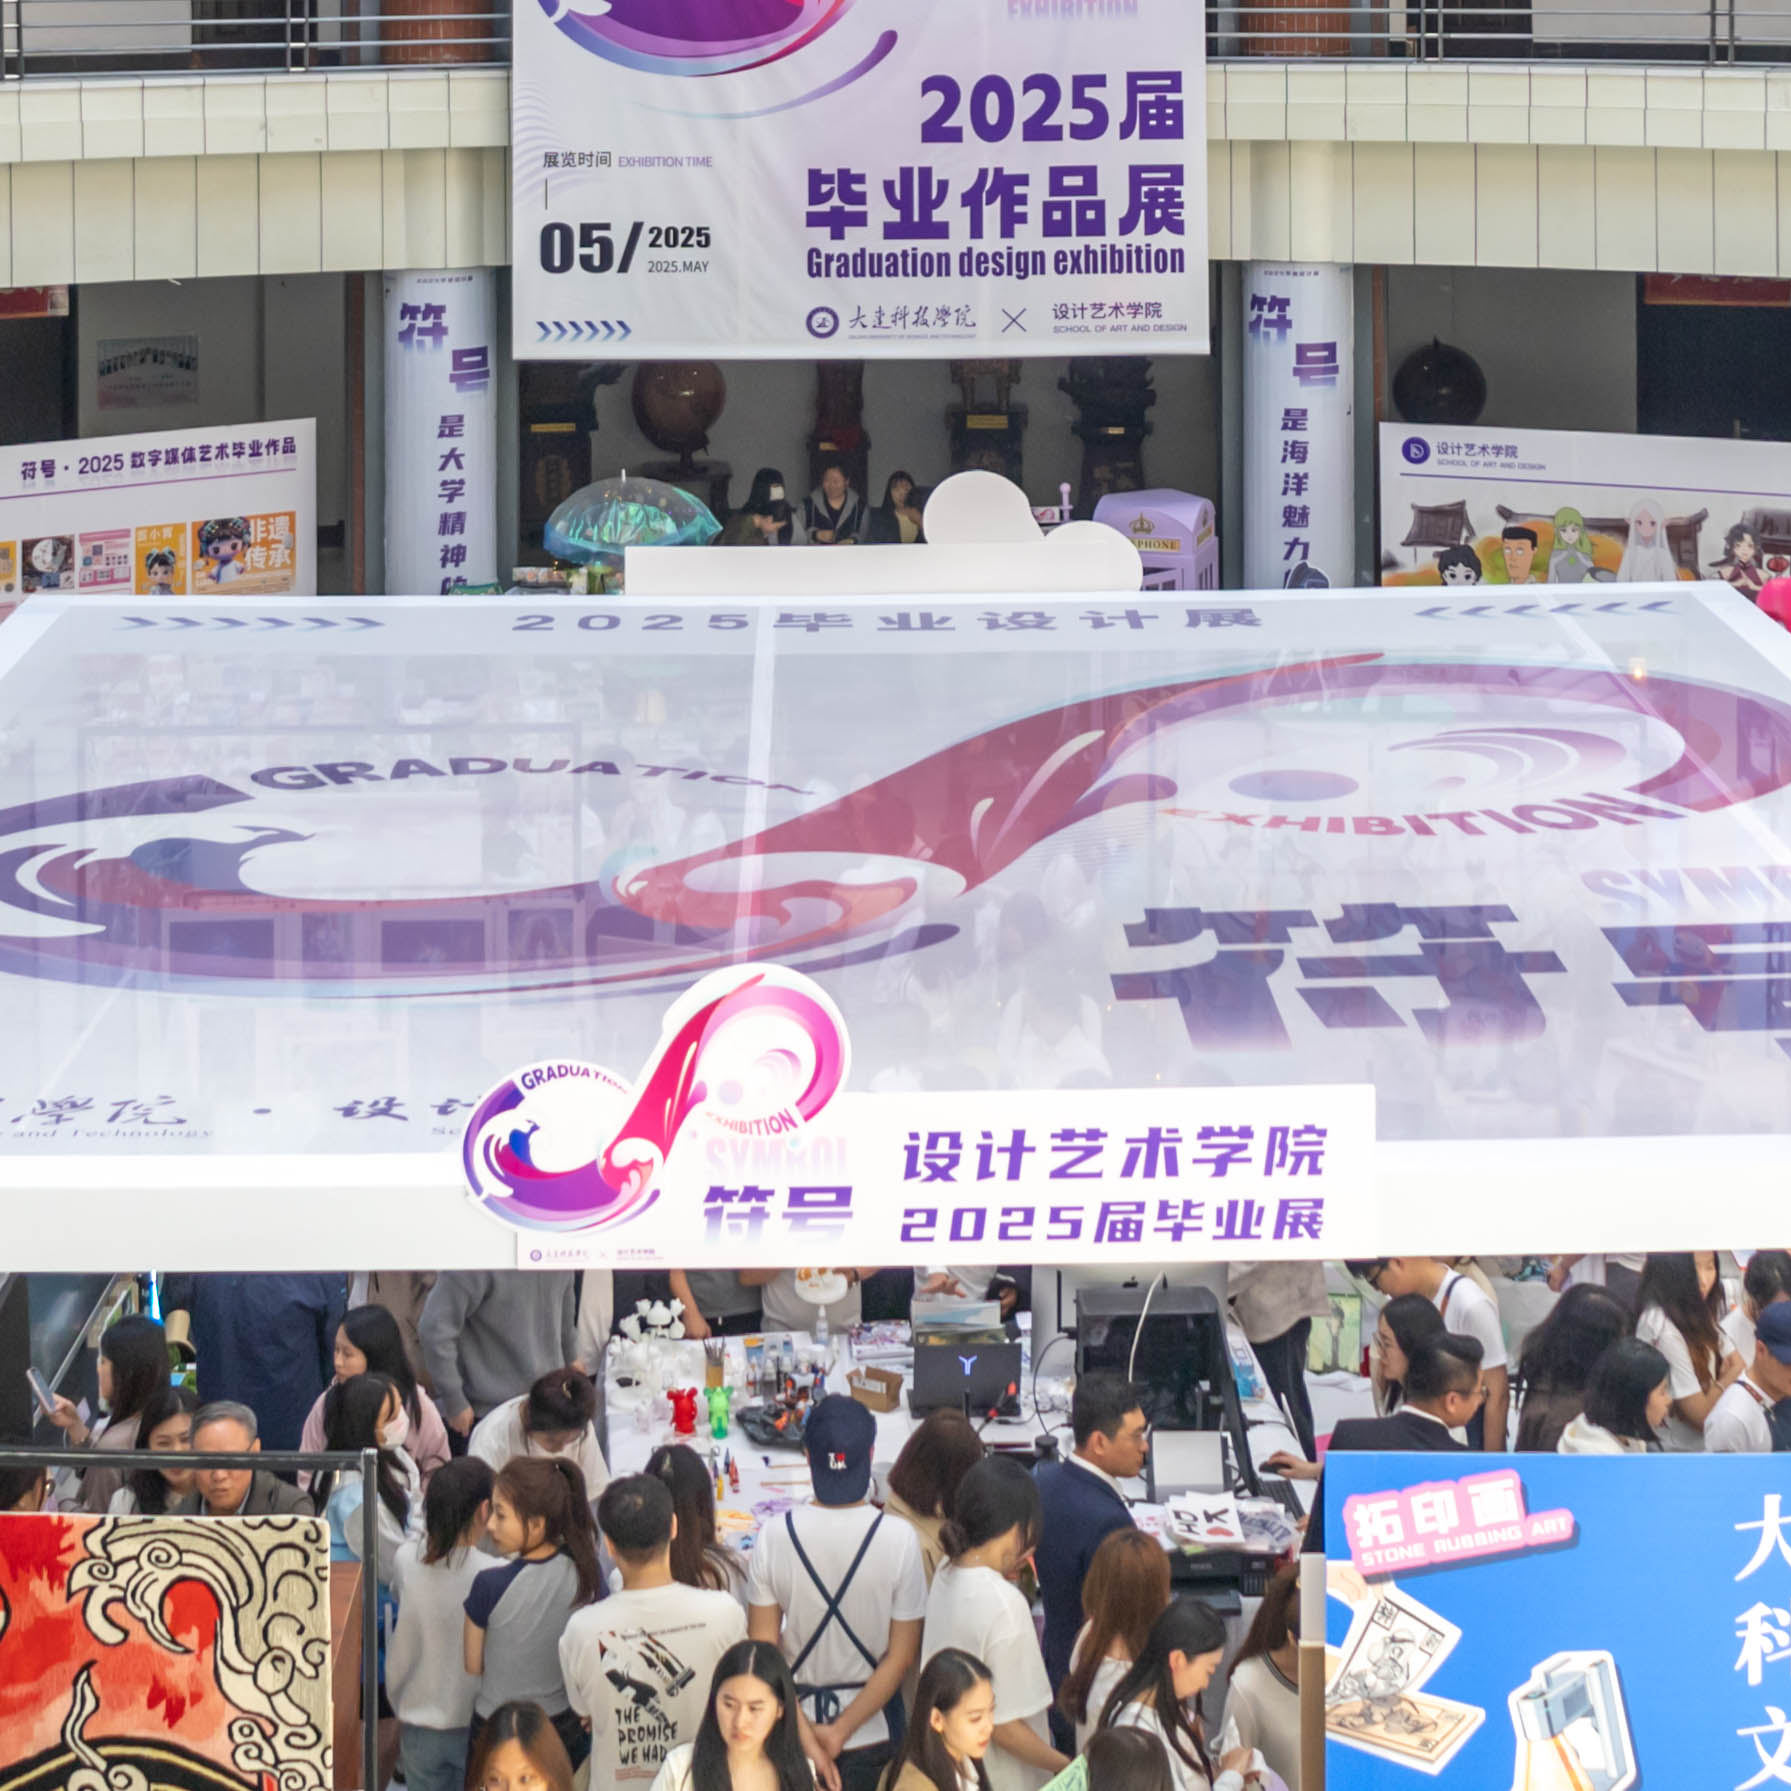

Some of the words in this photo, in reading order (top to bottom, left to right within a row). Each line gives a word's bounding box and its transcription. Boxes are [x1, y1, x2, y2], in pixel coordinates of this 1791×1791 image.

[920, 70, 1185, 144] 2025届
[543, 151, 612, 168] 展览时间
[618, 156, 683, 168] EXHIBITION
[687, 156, 713, 168] TIME
[806, 164, 1185, 241] 毕业作品展
[648, 226, 711, 248] 2025
[648, 260, 709, 273] 2025.MAY
[808, 246, 952, 278] Graduation
[958, 245, 1046, 281] design
[1053, 243, 1185, 276] exhibition
[1053, 302, 1163, 320] 设计艺术学院
[1094, 325, 1106, 333] OF
[1109, 324, 1127, 333] ART
[1130, 324, 1151, 332] AND
[1437, 441, 1518, 458] 设计艺术学院
[1281, 408, 1310, 588] 是海洋魅力
[903, 1124, 1328, 1182] 设计艺术学院
[703, 1185, 853, 1244] 符号
[900, 1198, 1325, 1244] 2025届毕业展
[1354, 1478, 1519, 1548] 拓印画
[1361, 1542, 1426, 1567] STONE
[1433, 1525, 1523, 1554] RUBBING
[1531, 1517, 1568, 1537] ART
[615, 1706, 641, 1724] THE
[618, 1721, 678, 1746] PROMISE
[619, 1747, 637, 1765] WE
[643, 1744, 668, 1764] HAD
